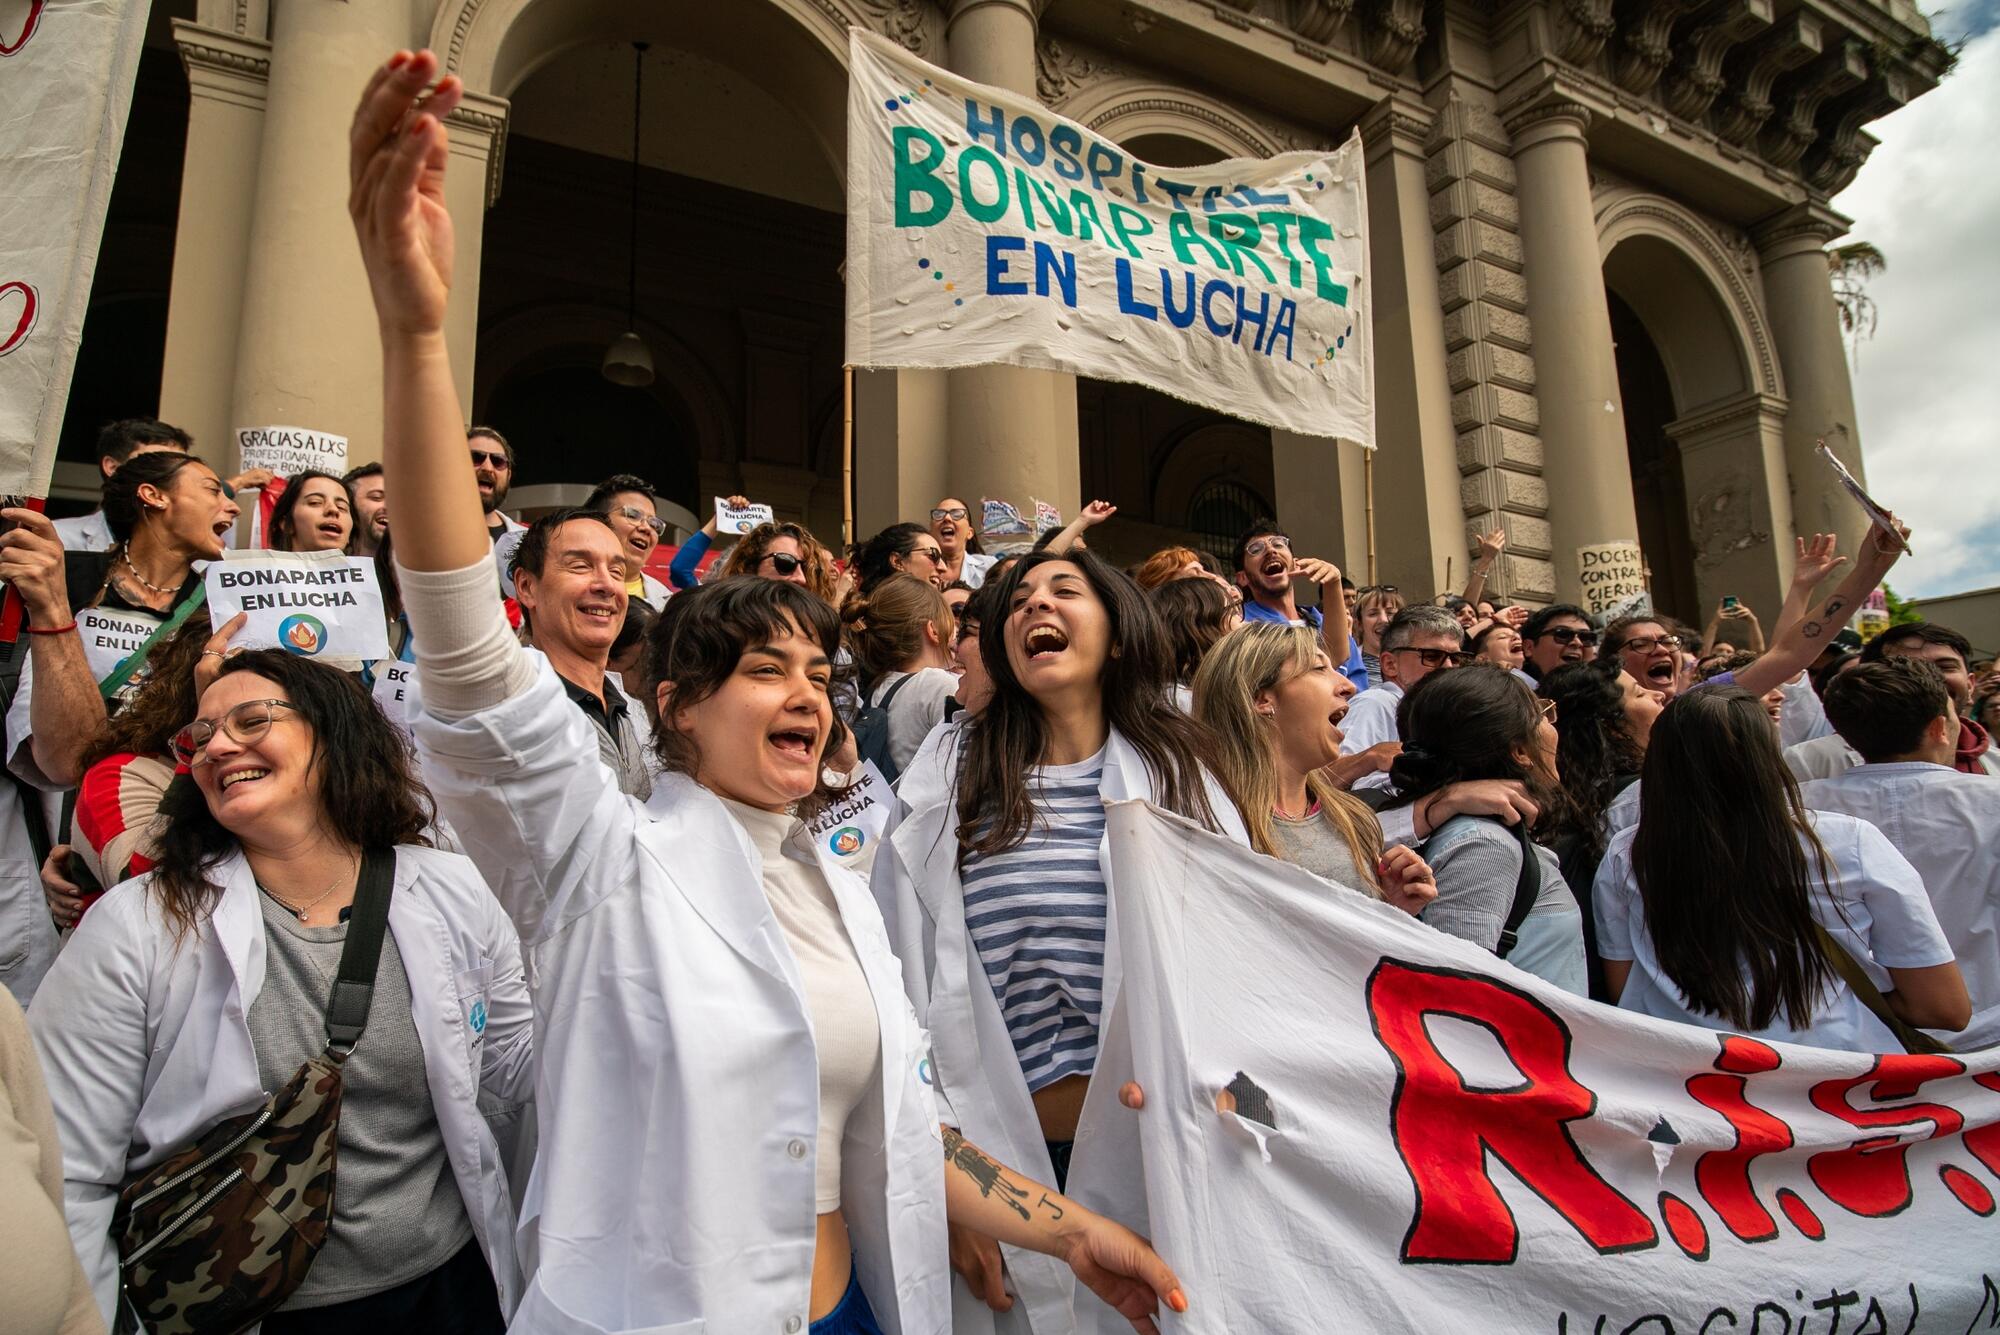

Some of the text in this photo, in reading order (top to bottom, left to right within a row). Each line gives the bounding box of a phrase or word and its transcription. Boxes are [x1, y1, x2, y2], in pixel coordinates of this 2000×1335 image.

[893, 126, 1349, 307] BONAPARTE
[986, 235, 1297, 361] EN LUCHA
[240, 430, 346, 458] GRACIAS A LXS
[244, 448, 325, 466] PROFESIONALES
[720, 502, 767, 514] BONAPARTE
[725, 512, 735, 520] EN
[1582, 549, 1640, 568] DOCEN
[219, 568, 364, 588] BONAPARTE
[1581, 567, 1636, 584] CONTRA
[241, 591, 357, 611] EN LUCHA
[85, 615, 158, 635] BONAPA
[95, 635, 142, 652] EN LU
[395, 689, 404, 701] E
[821, 796, 875, 830] LUCHA
